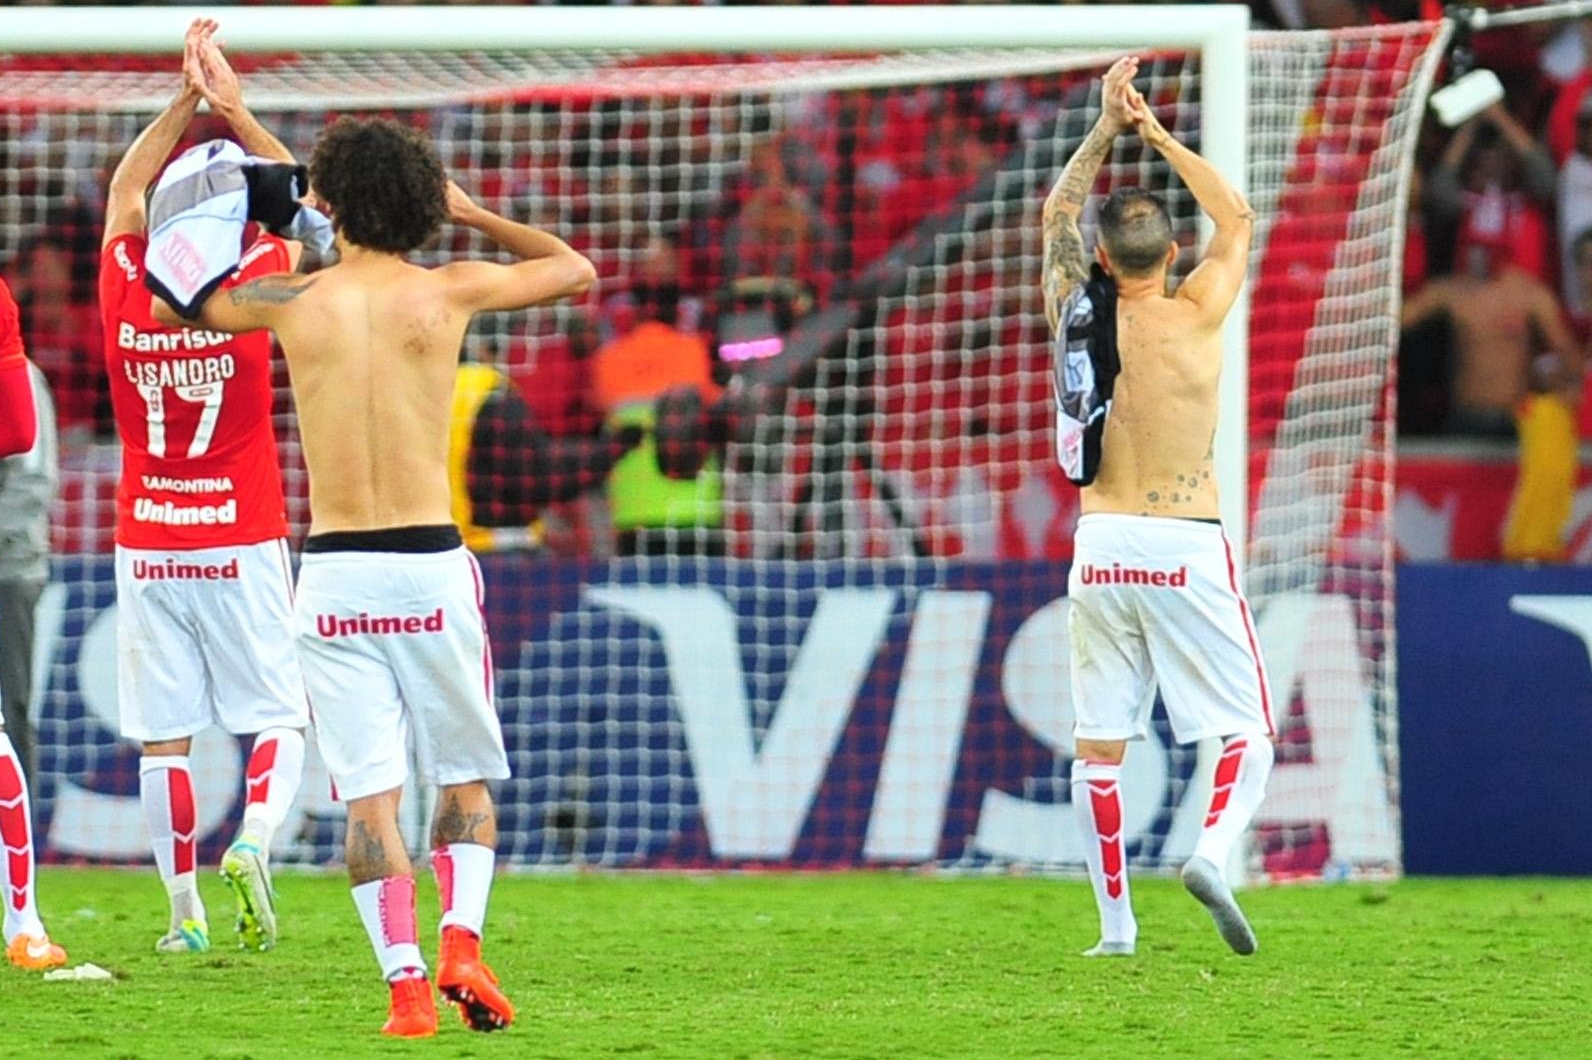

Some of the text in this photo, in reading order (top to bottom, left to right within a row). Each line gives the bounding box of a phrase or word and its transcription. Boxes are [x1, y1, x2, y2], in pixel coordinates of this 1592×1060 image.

[124, 353, 235, 388] LISANDRO
[136, 380, 225, 459] 17
[133, 497, 238, 526] Unimed
[132, 557, 239, 580] Unimed
[1080, 562, 1187, 588] Unimed
[316, 609, 444, 638] Unimed
[583, 586, 1396, 864] VISA
